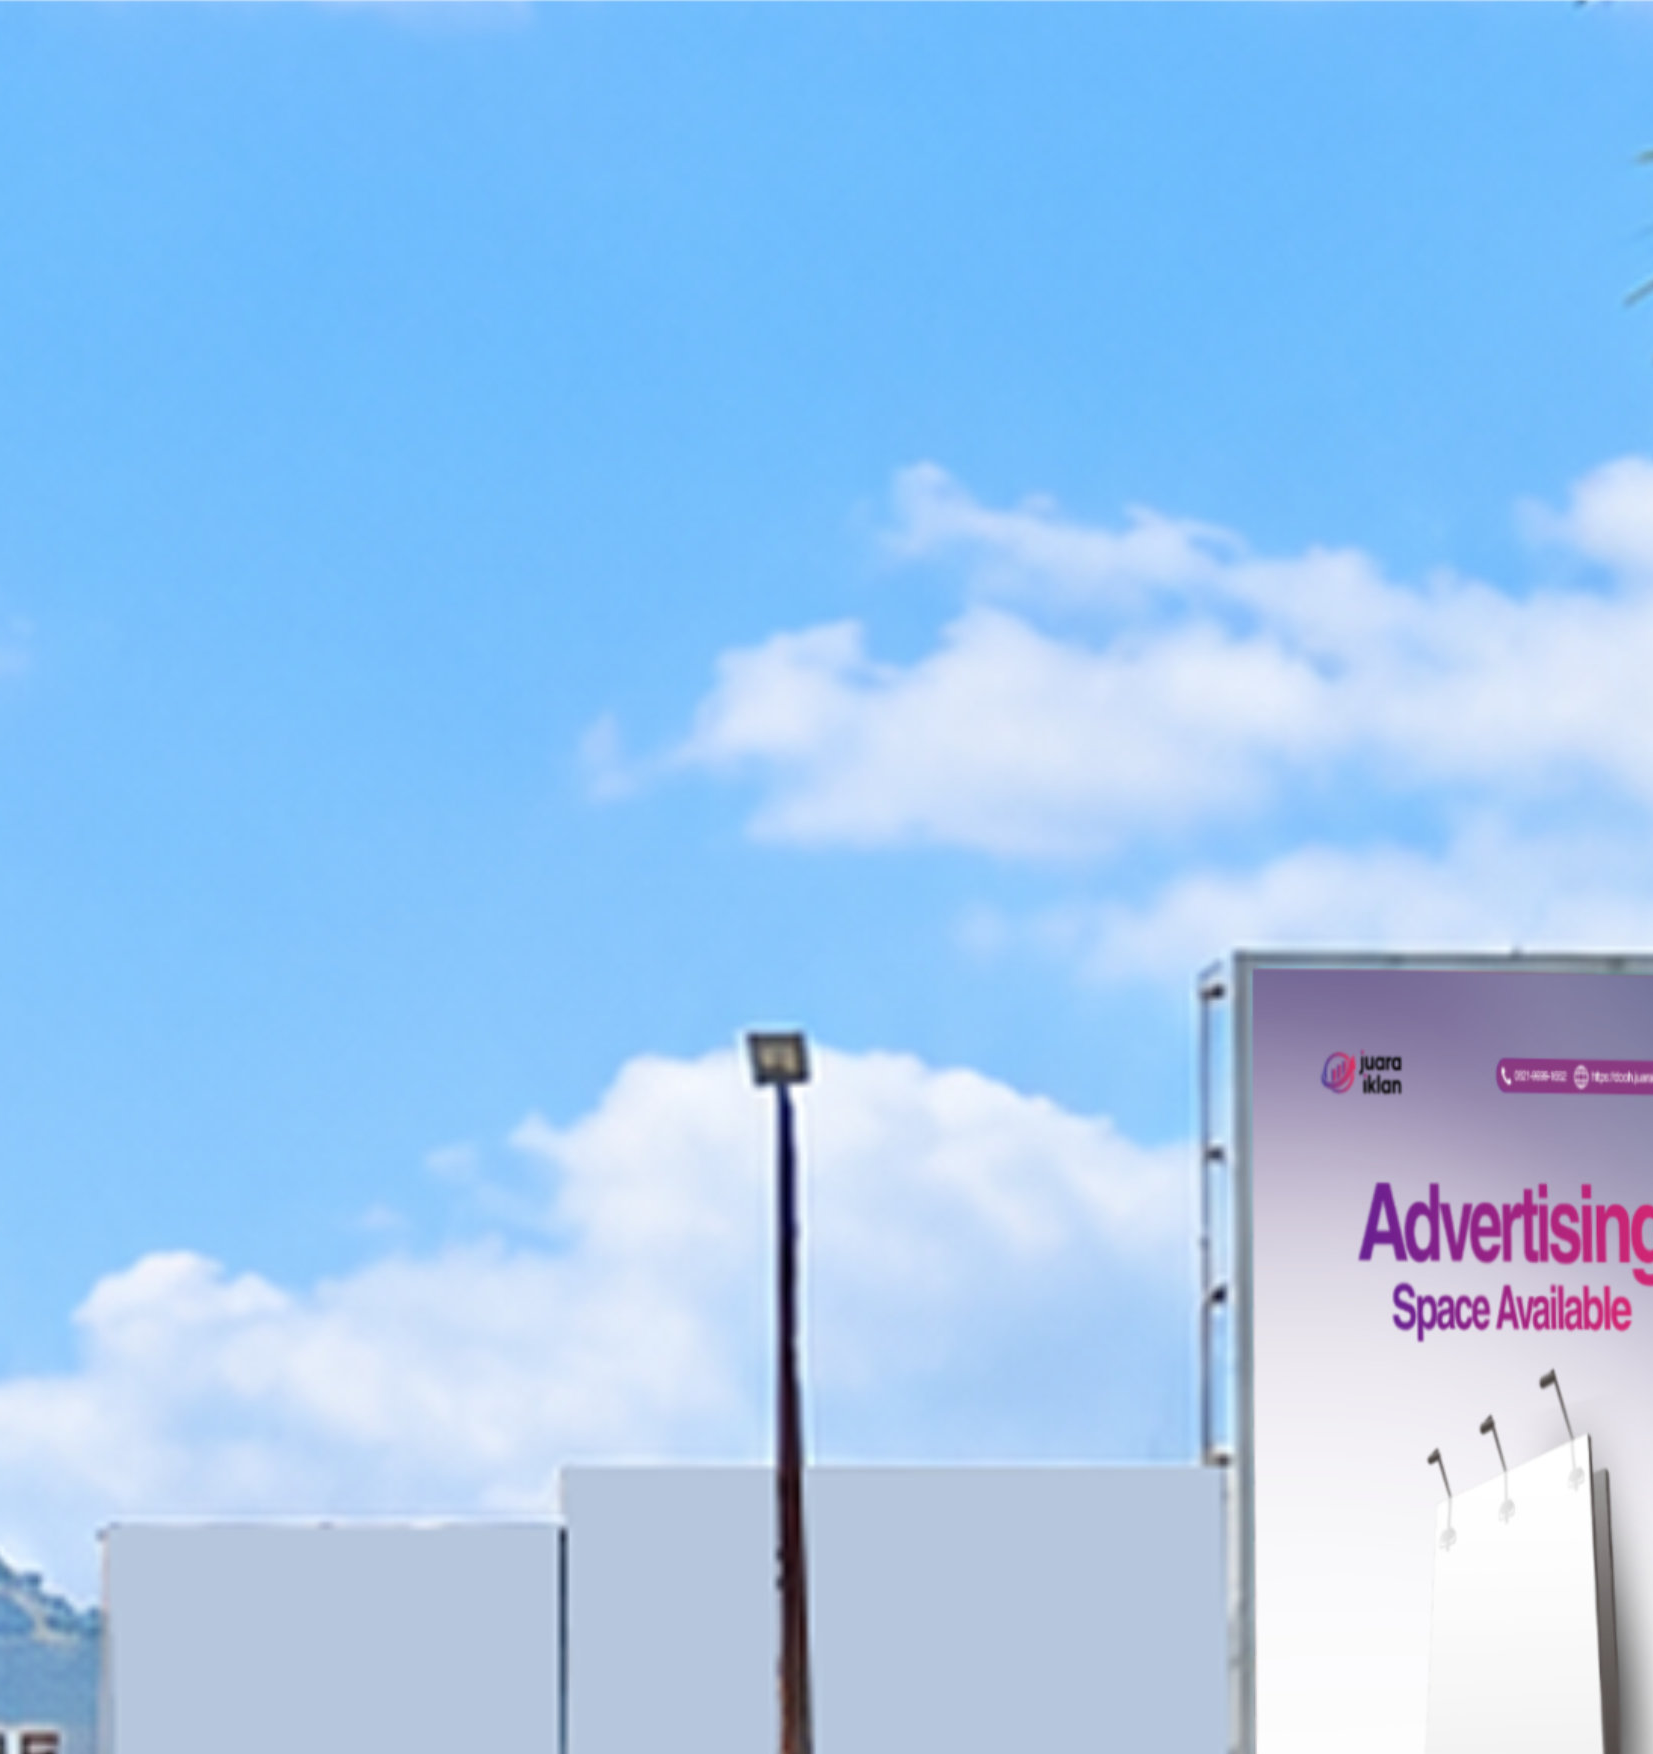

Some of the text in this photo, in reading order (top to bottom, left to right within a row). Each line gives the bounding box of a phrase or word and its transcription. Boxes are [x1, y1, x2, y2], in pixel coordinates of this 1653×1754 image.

[1359, 1049, 1402, 1075] juara
[1363, 1073, 1402, 1094] iklan
[1392, 1282, 1632, 1342] Space Available
